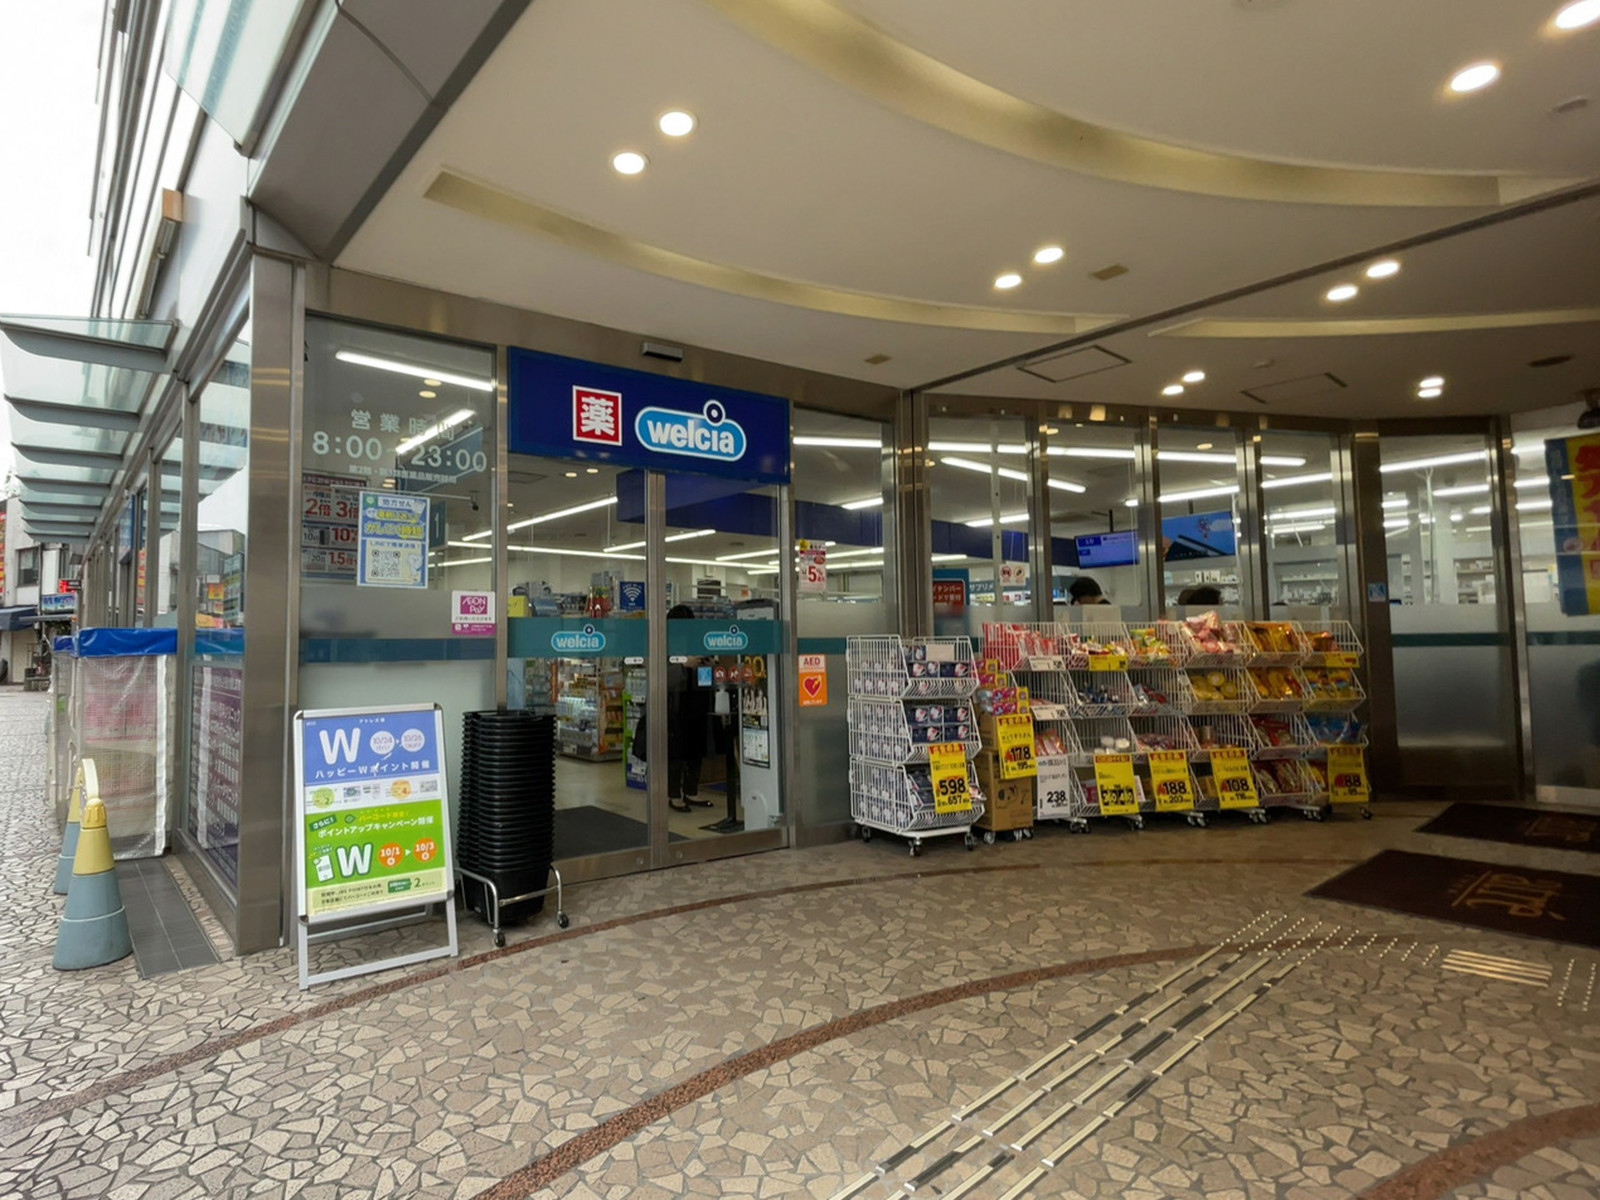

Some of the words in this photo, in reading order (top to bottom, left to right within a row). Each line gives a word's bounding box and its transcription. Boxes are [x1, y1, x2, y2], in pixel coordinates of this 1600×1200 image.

[580, 396, 615, 437] 薬
[646, 415, 735, 455] welcia
[312, 430, 383, 461] 8:00
[411, 444, 487, 472] 23:00
[555, 633, 600, 649] welcia
[707, 634, 743, 648] welcia
[803, 657, 821, 666] AED
[319, 727, 361, 765] W
[1010, 746, 1031, 761] 178
[939, 777, 966, 796] 598
[1162, 781, 1187, 795] 188
[1226, 778, 1249, 792] 108
[1046, 790, 1066, 803] 238
[380, 847, 401, 858] 10/1
[415, 842, 435, 853] 10/3
[336, 843, 373, 877] W
